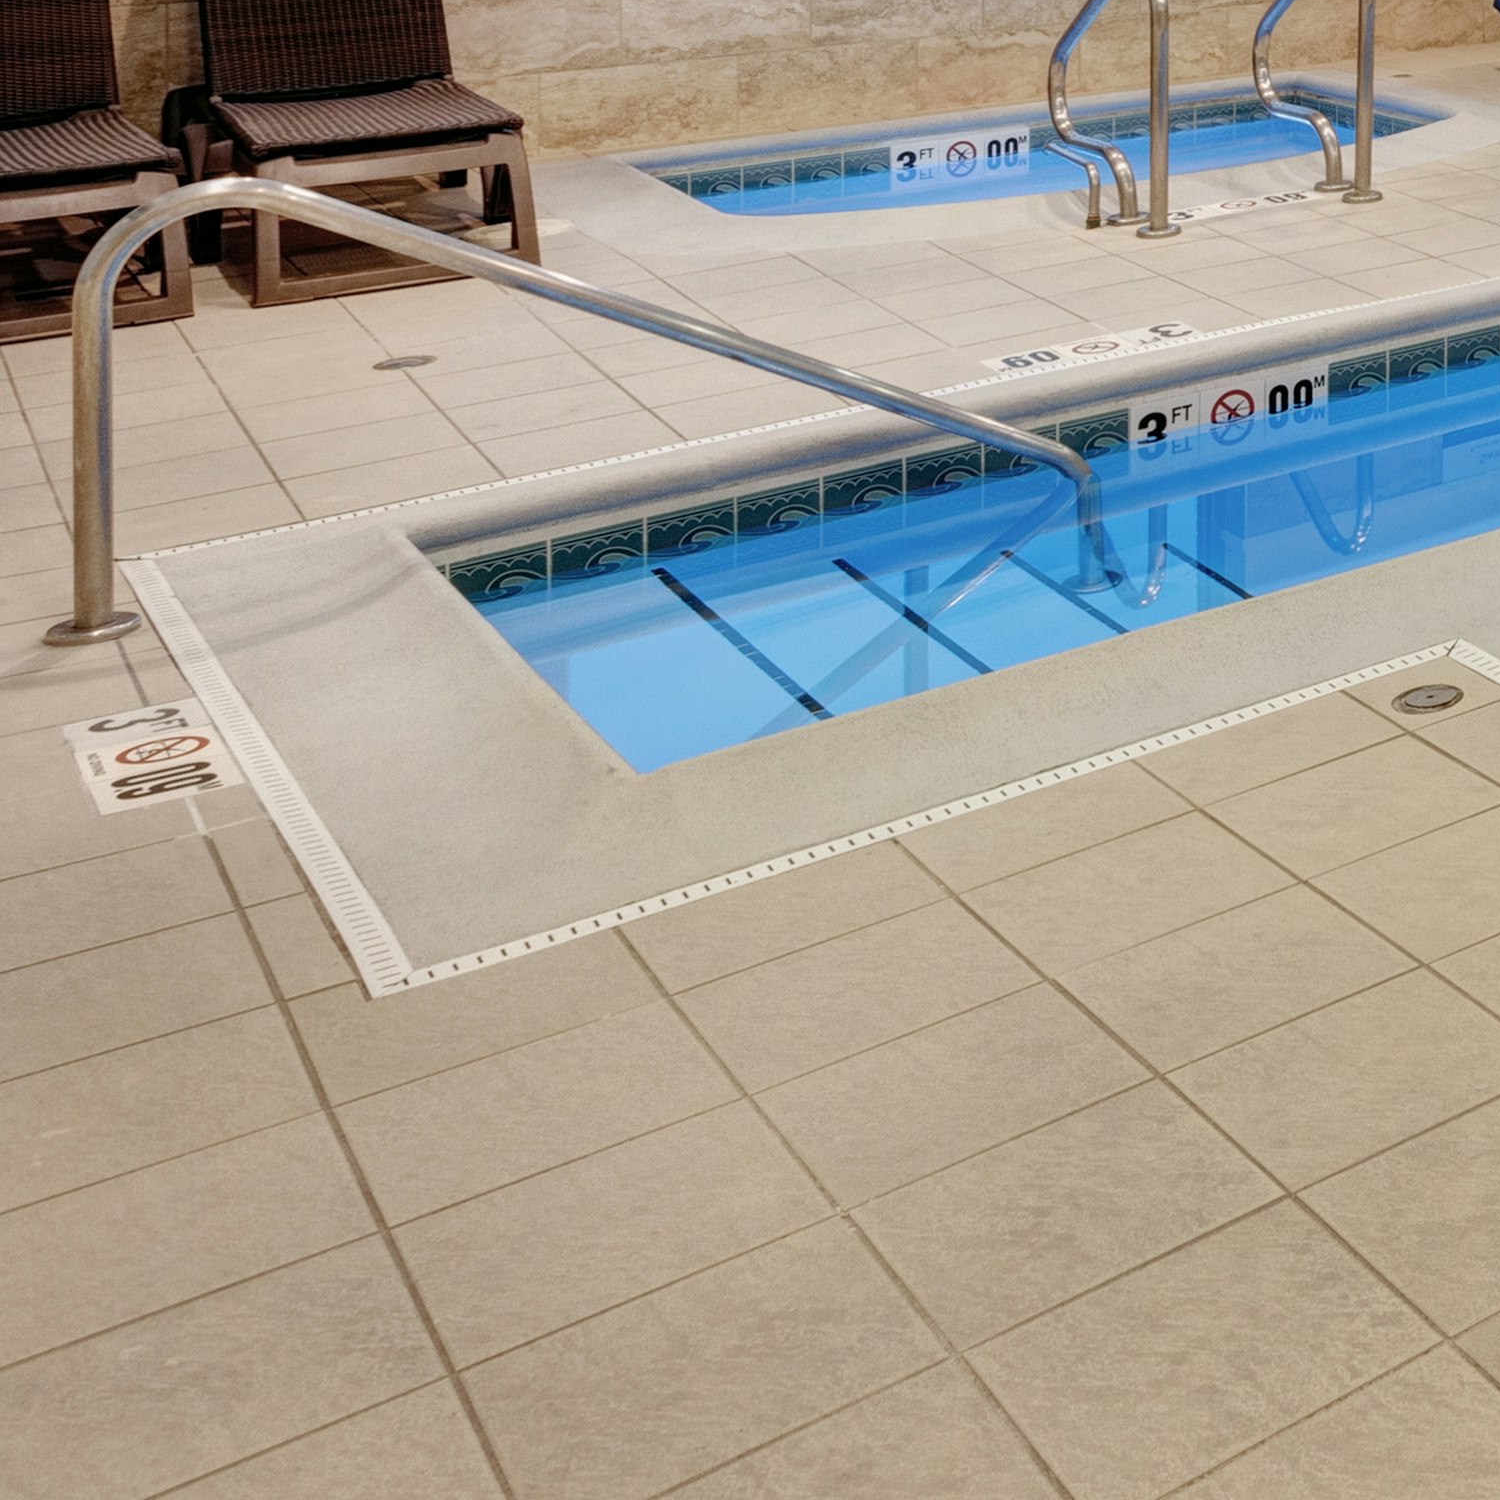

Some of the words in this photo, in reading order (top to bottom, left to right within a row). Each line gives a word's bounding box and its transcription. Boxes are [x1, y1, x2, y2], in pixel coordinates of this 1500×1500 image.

[920, 148, 934, 160] FT
[1019, 136, 1027, 144] M
[1137, 412, 1168, 445] 3
[1171, 404, 1193, 424] FT
[1314, 375, 1325, 389] M
[88, 708, 180, 732] 3
[150, 717, 189, 733] FT
